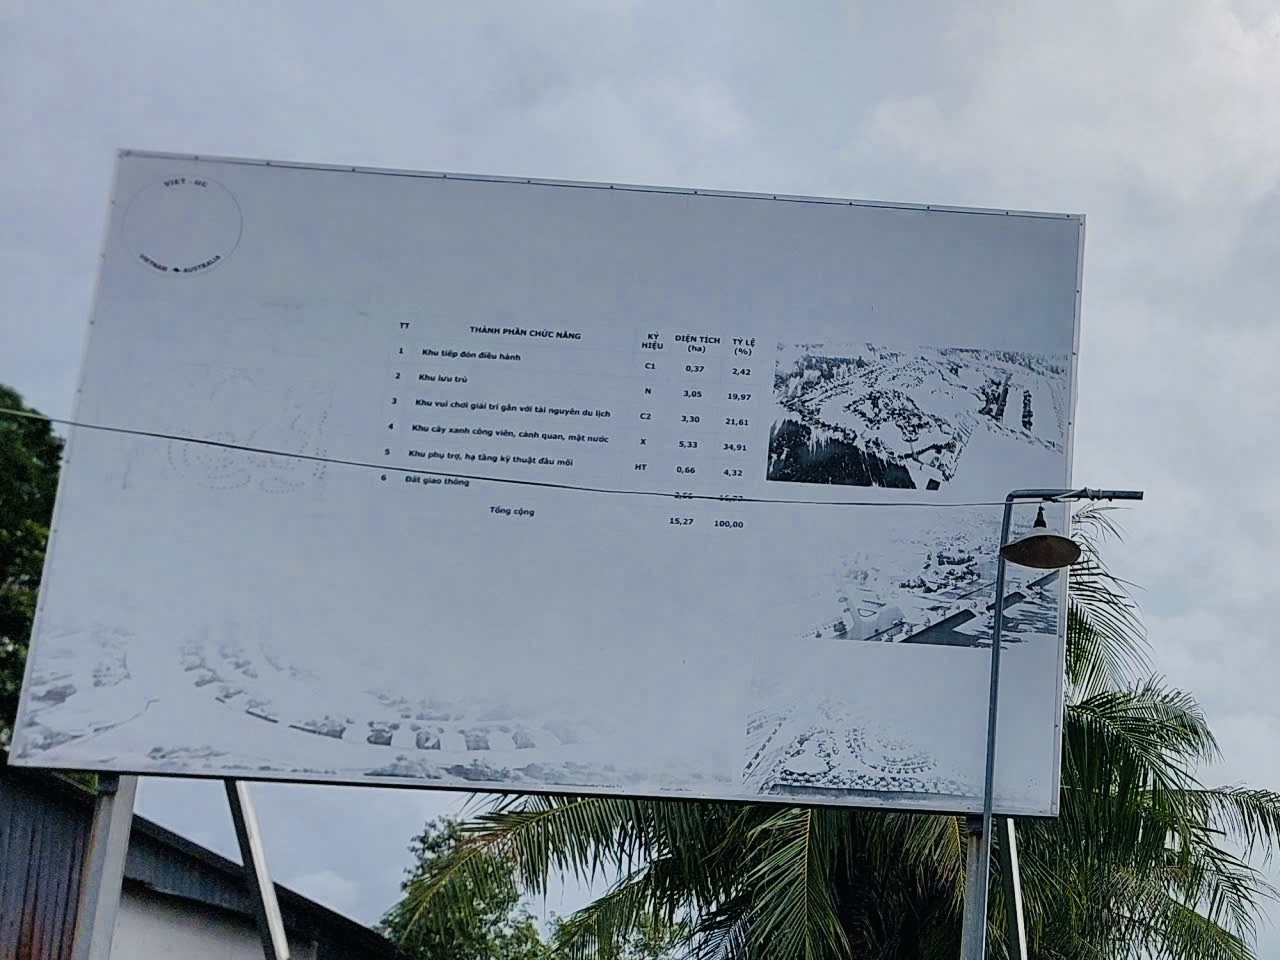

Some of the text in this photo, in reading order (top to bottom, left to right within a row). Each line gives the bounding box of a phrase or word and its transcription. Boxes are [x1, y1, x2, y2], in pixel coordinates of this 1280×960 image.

[399, 322, 410, 330] TT
[675, 334, 720, 344] DIỆN TÍCH
[641, 340, 664, 350] HIỆU
[687, 344, 706, 354] (ha)
[421, 348, 439, 358] Khu
[734, 347, 752, 356] (%)
[644, 362, 656, 370] C1
[685, 364, 705, 373] 0,37
[732, 367, 751, 376] 2,42
[418, 373, 436, 382] Khu
[644, 387, 652, 395] N
[683, 390, 703, 398] 3,05
[727, 392, 752, 401] 19,97
[415, 398, 433, 407] Khu
[435, 399, 449, 408] vui
[582, 408, 594, 418] du
[640, 412, 652, 420] C2
[681, 415, 700, 424] 3,30
[725, 417, 749, 426] 21,61
[411, 424, 429, 433] Khu
[448, 426, 470, 435] xanh
[541, 431, 565, 442] quan,
[640, 438, 647, 446] X
[678, 440, 698, 449] 5,33
[723, 443, 747, 452] 34,91
[408, 449, 426, 459] Khu
[634, 463, 648, 471] HT
[676, 465, 696, 474] 0,66
[723, 469, 743, 477] 4,32
[423, 476, 442, 487] giao
[669, 517, 694, 526] 15,27
[714, 520, 744, 529] 100,00
